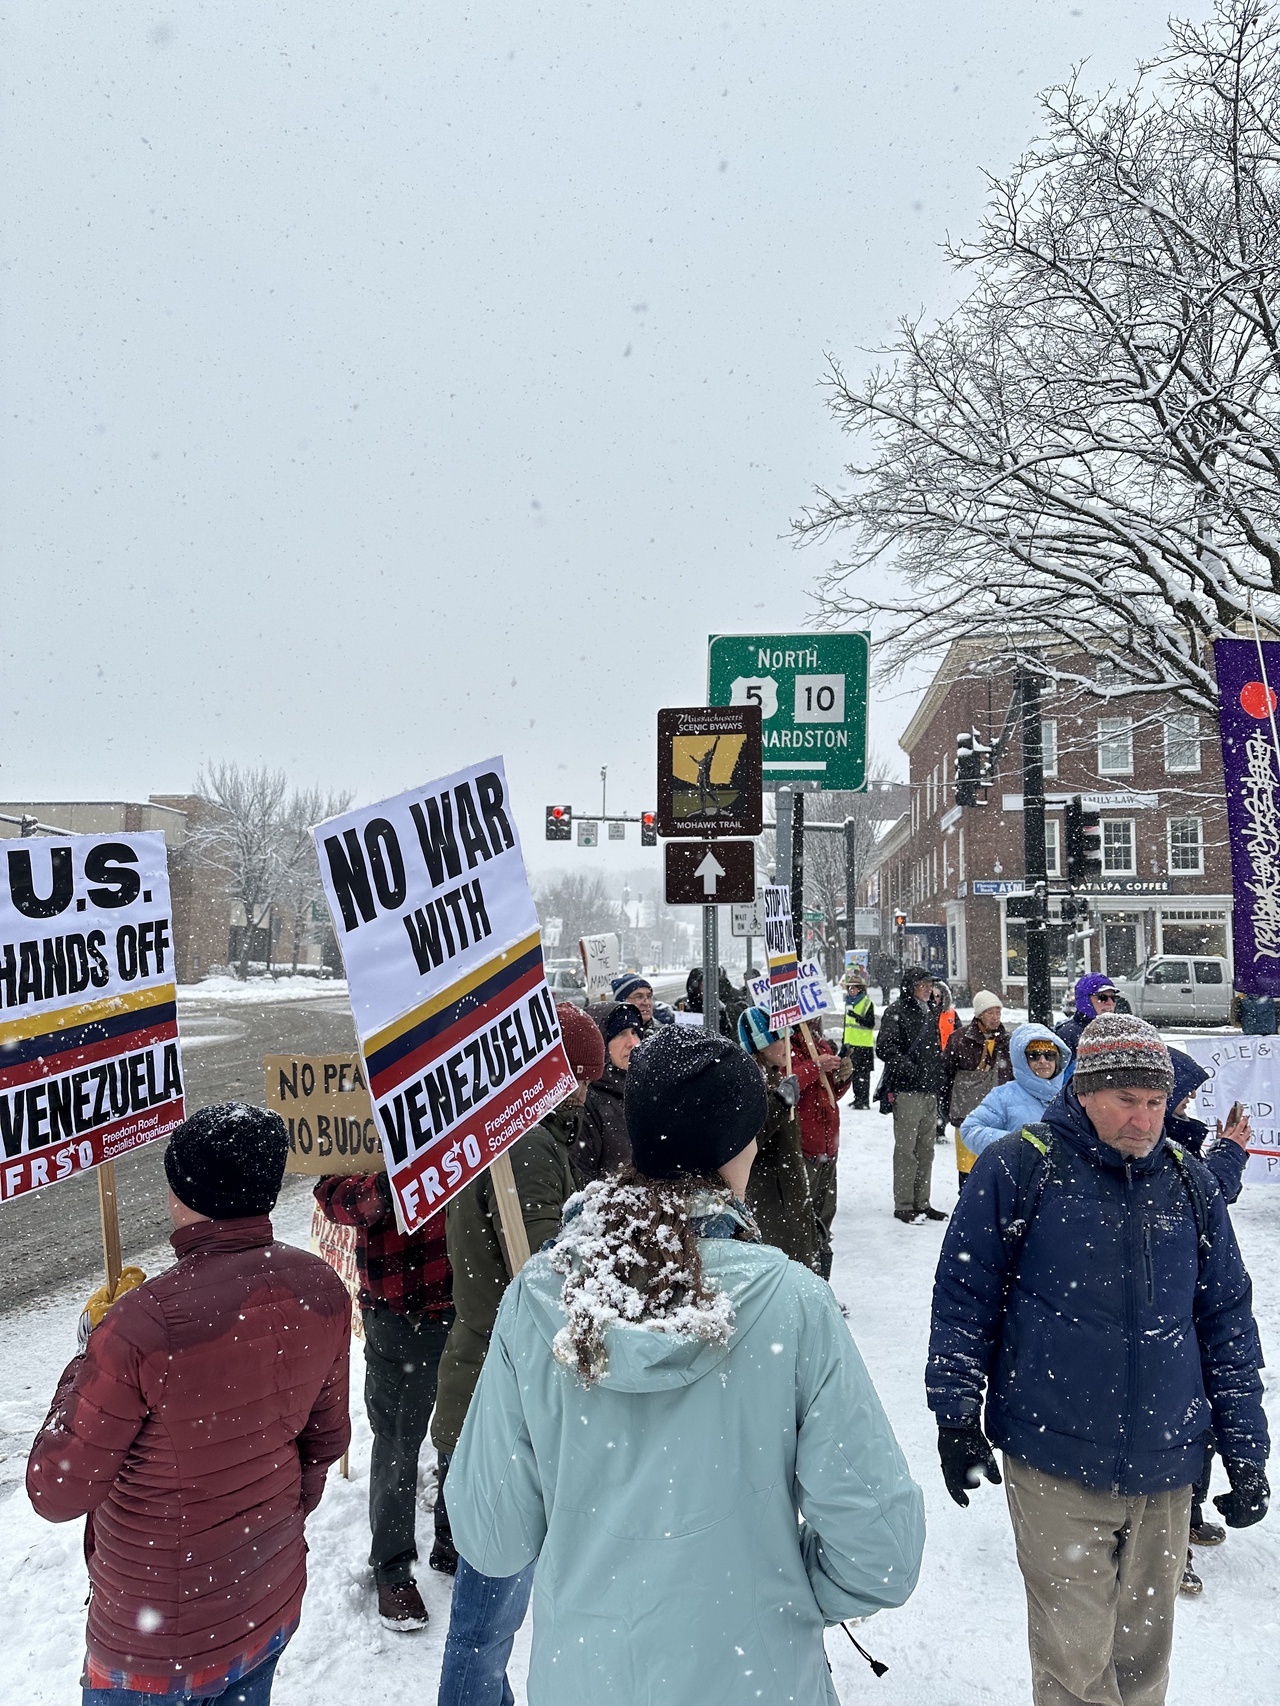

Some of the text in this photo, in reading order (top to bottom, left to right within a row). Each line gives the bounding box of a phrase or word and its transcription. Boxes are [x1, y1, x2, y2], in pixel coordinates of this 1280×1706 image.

[758, 648, 818, 668] NORTH
[746, 685, 835, 711] 5 10
[676, 713, 743, 725] Massachusetts
[710, 722, 743, 730] BYWAYS
[762, 730, 848, 748] NARDSTON
[1082, 796, 1111, 804] AMILY
[324, 772, 515, 932] NO WAR
[7, 843, 152, 918] U.S.
[999, 882, 1023, 892] ATM
[1126, 882, 1168, 890] COFFEE
[765, 889, 780, 918] STOP
[403, 878, 492, 976] WITH
[0, 919, 170, 1008] HANDS OFF
[589, 940, 606, 958] STOP
[279, 1062, 315, 1100] NO
[379, 987, 560, 1166] VENEZUELA!
[1202, 1045, 1251, 1108] PEOPLE
[1258, 1043, 1271, 1055] &
[0, 1043, 183, 1158] VENEZUELA
[485, 1078, 545, 1135] Freedom Road
[488, 1075, 574, 1151] Socialist Organization
[102, 1114, 159, 1145] Freedom Road
[103, 1118, 183, 1158] Socialist Organization
[317, 1114, 383, 1157] BUDG
[5, 1141, 94, 1197] FRSO
[401, 1134, 481, 1221] FRSO
